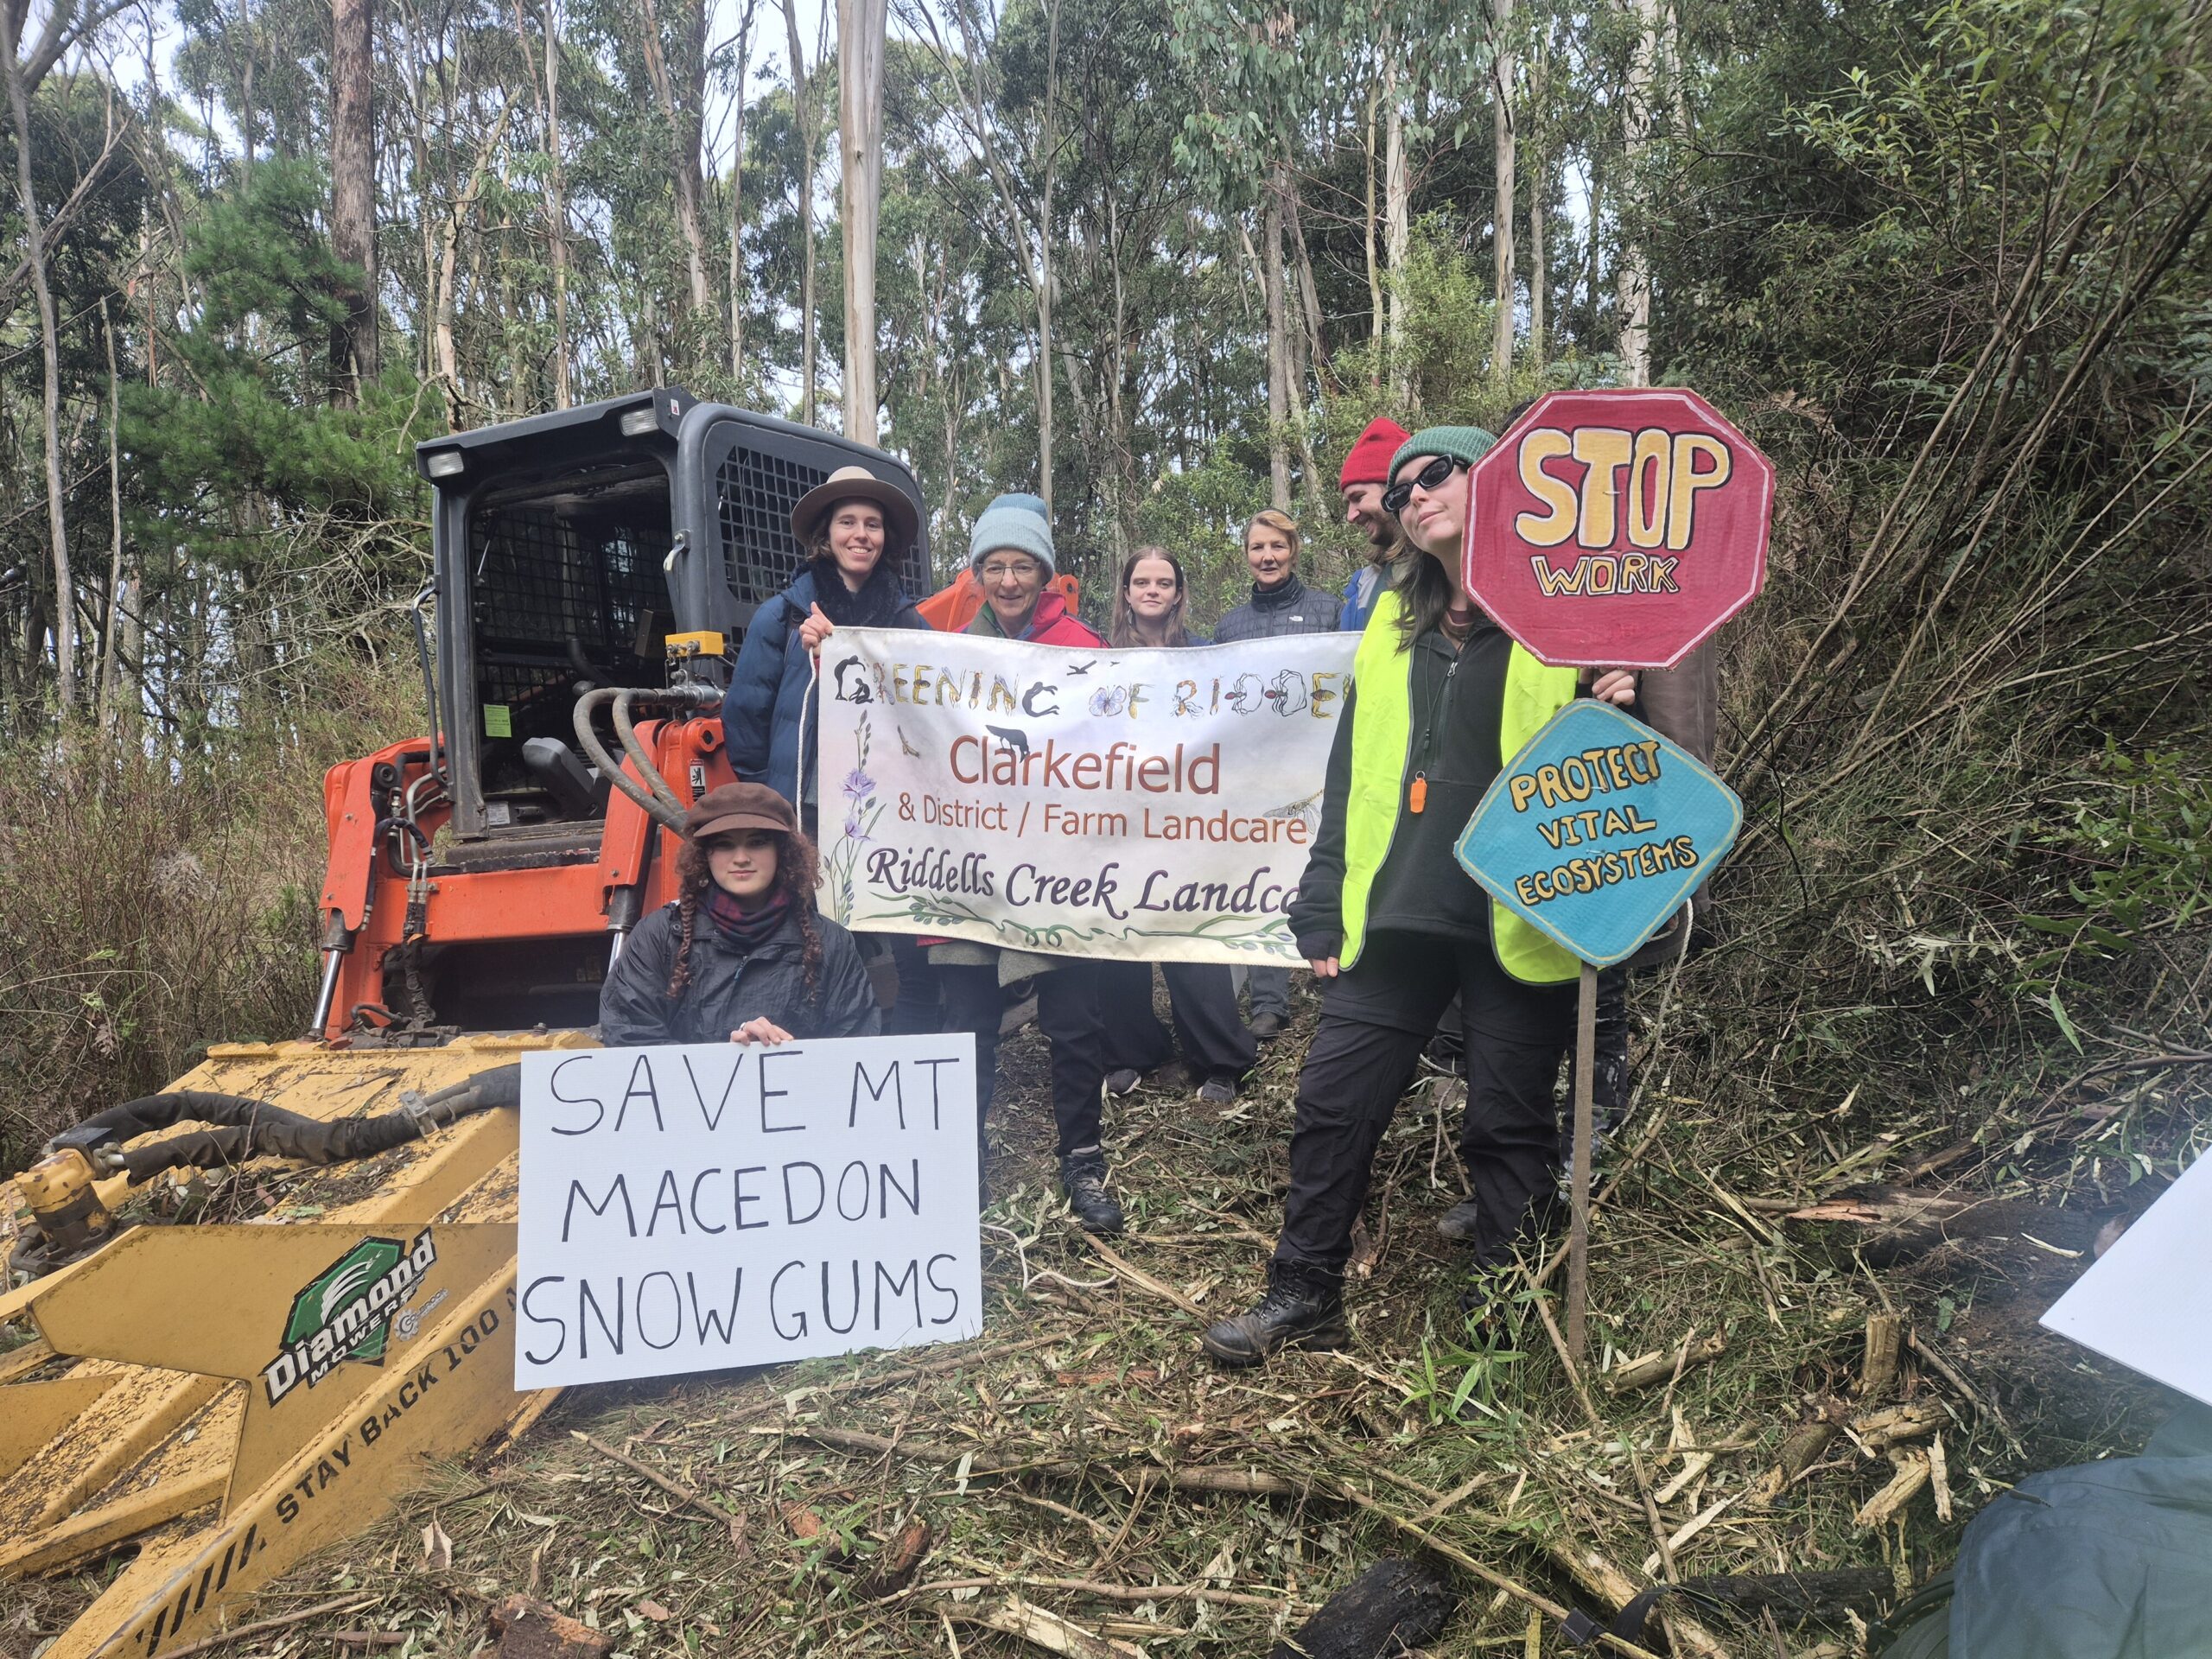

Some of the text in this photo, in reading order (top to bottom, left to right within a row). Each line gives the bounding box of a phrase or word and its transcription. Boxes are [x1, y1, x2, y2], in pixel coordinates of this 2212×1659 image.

[1515, 427, 1732, 550] STOP
[1531, 554, 1680, 596] WORK
[1087, 679, 1154, 719] OF
[950, 734, 1221, 795] Clarkefield
[1509, 741, 1661, 814] PROTECT
[898, 791, 1307, 844] & District / Farm Landcare
[1537, 804, 1657, 849] VITAL
[867, 847, 995, 896] Riddells
[1005, 862, 1129, 920] Creek
[1515, 836, 1699, 906] ECOSYSTEMS
[550, 1051, 960, 1135] SAVE MT
[562, 1159, 920, 1243] MACEDON
[264, 1232, 435, 1401] Diamond
[311, 1286, 417, 1382] MOWERS
[521, 1254, 959, 1365] SNOW GUMS
[276, 1308, 499, 1524] STAY BACK 100
